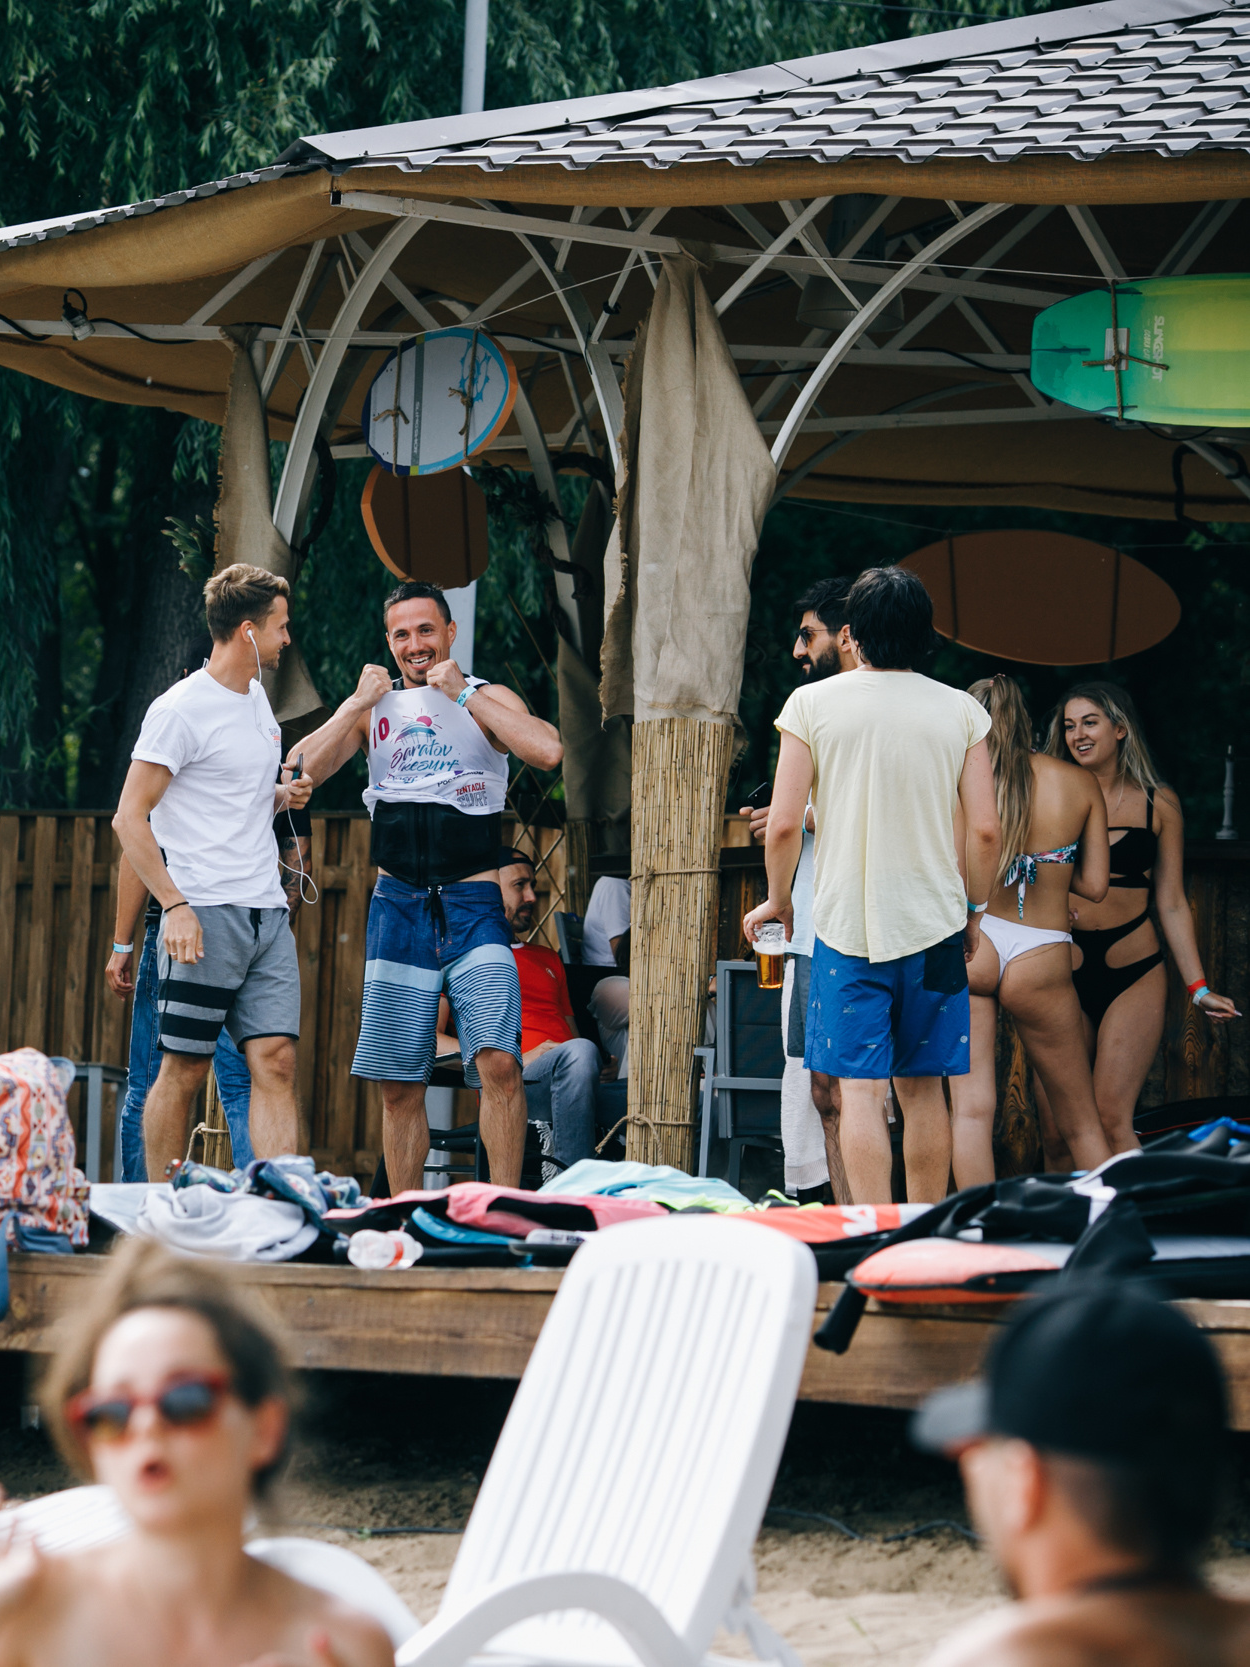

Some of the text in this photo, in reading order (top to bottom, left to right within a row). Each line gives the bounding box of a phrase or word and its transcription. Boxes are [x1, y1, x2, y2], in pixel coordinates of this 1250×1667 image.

[391, 739, 452, 769] Saratov
[397, 759, 459, 772] kesurf
[456, 782, 485, 797] TENTACLE
